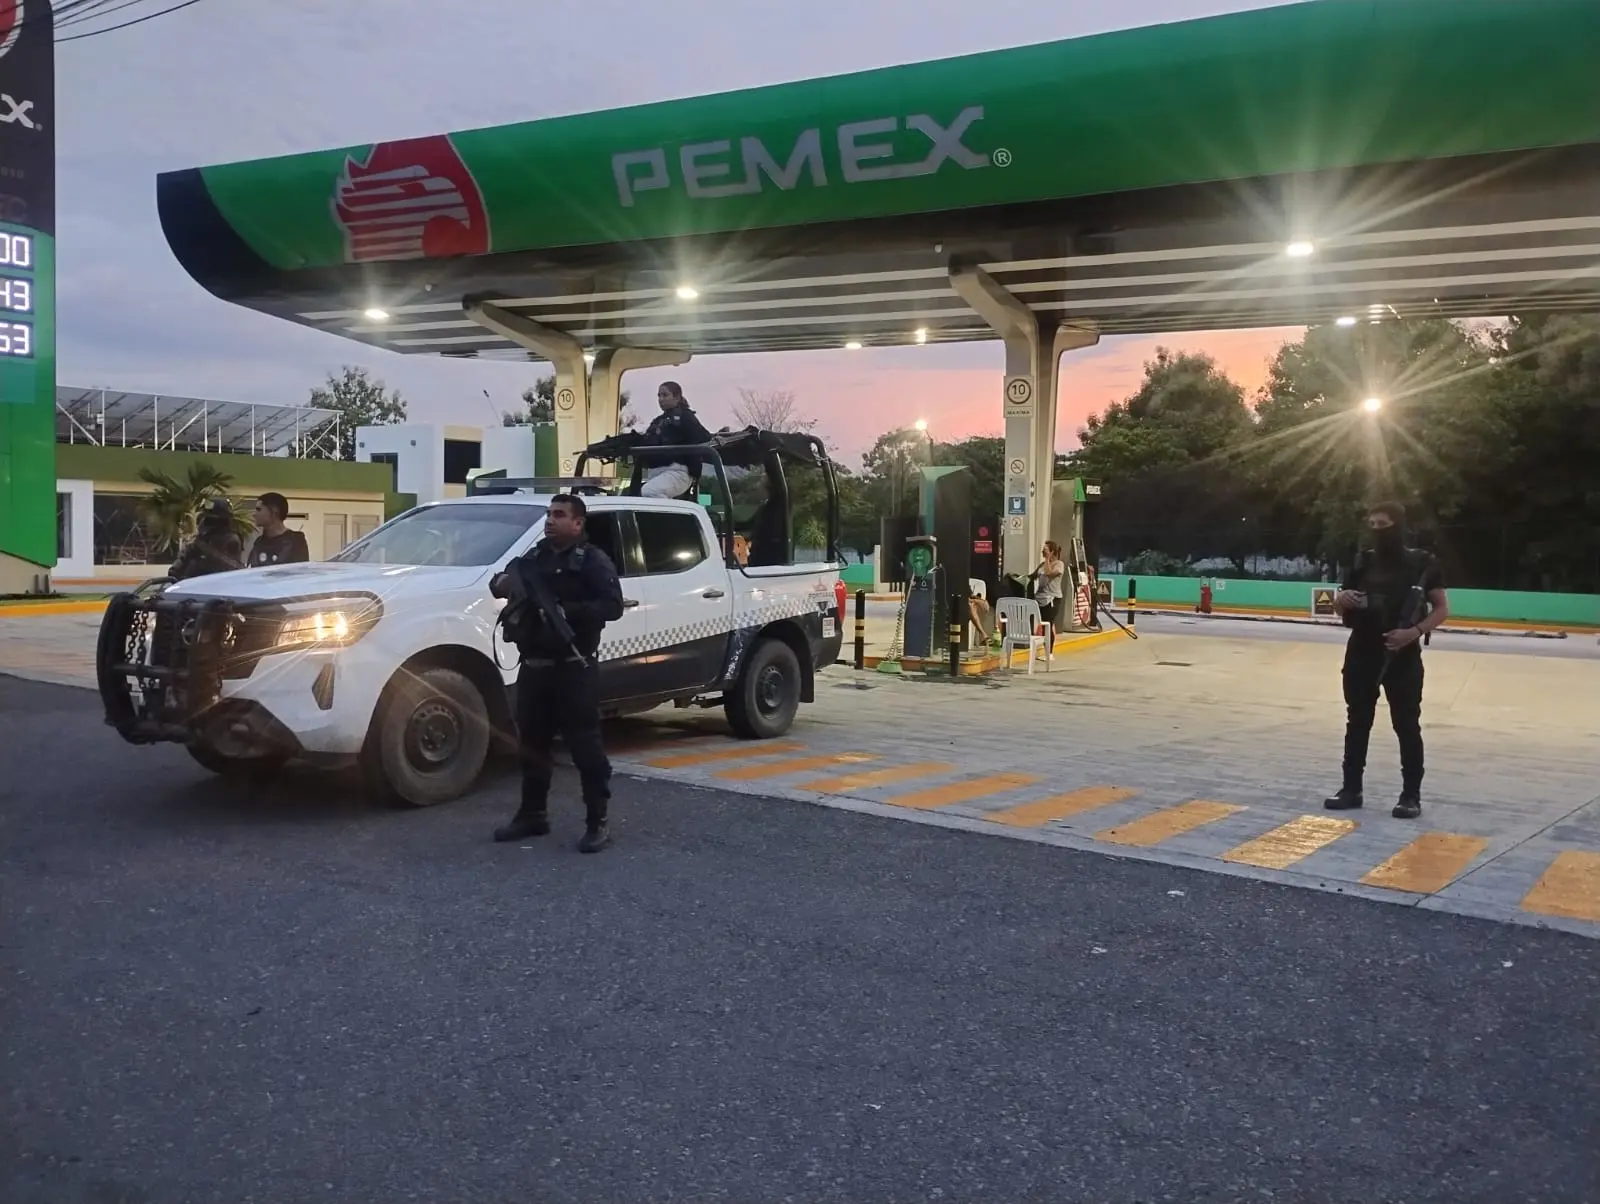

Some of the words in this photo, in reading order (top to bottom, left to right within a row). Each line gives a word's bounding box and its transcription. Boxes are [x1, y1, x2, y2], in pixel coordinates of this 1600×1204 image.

[611, 105, 991, 208] PEMEX
[1012, 383, 1026, 396] 10
[562, 393, 571, 402] 10
